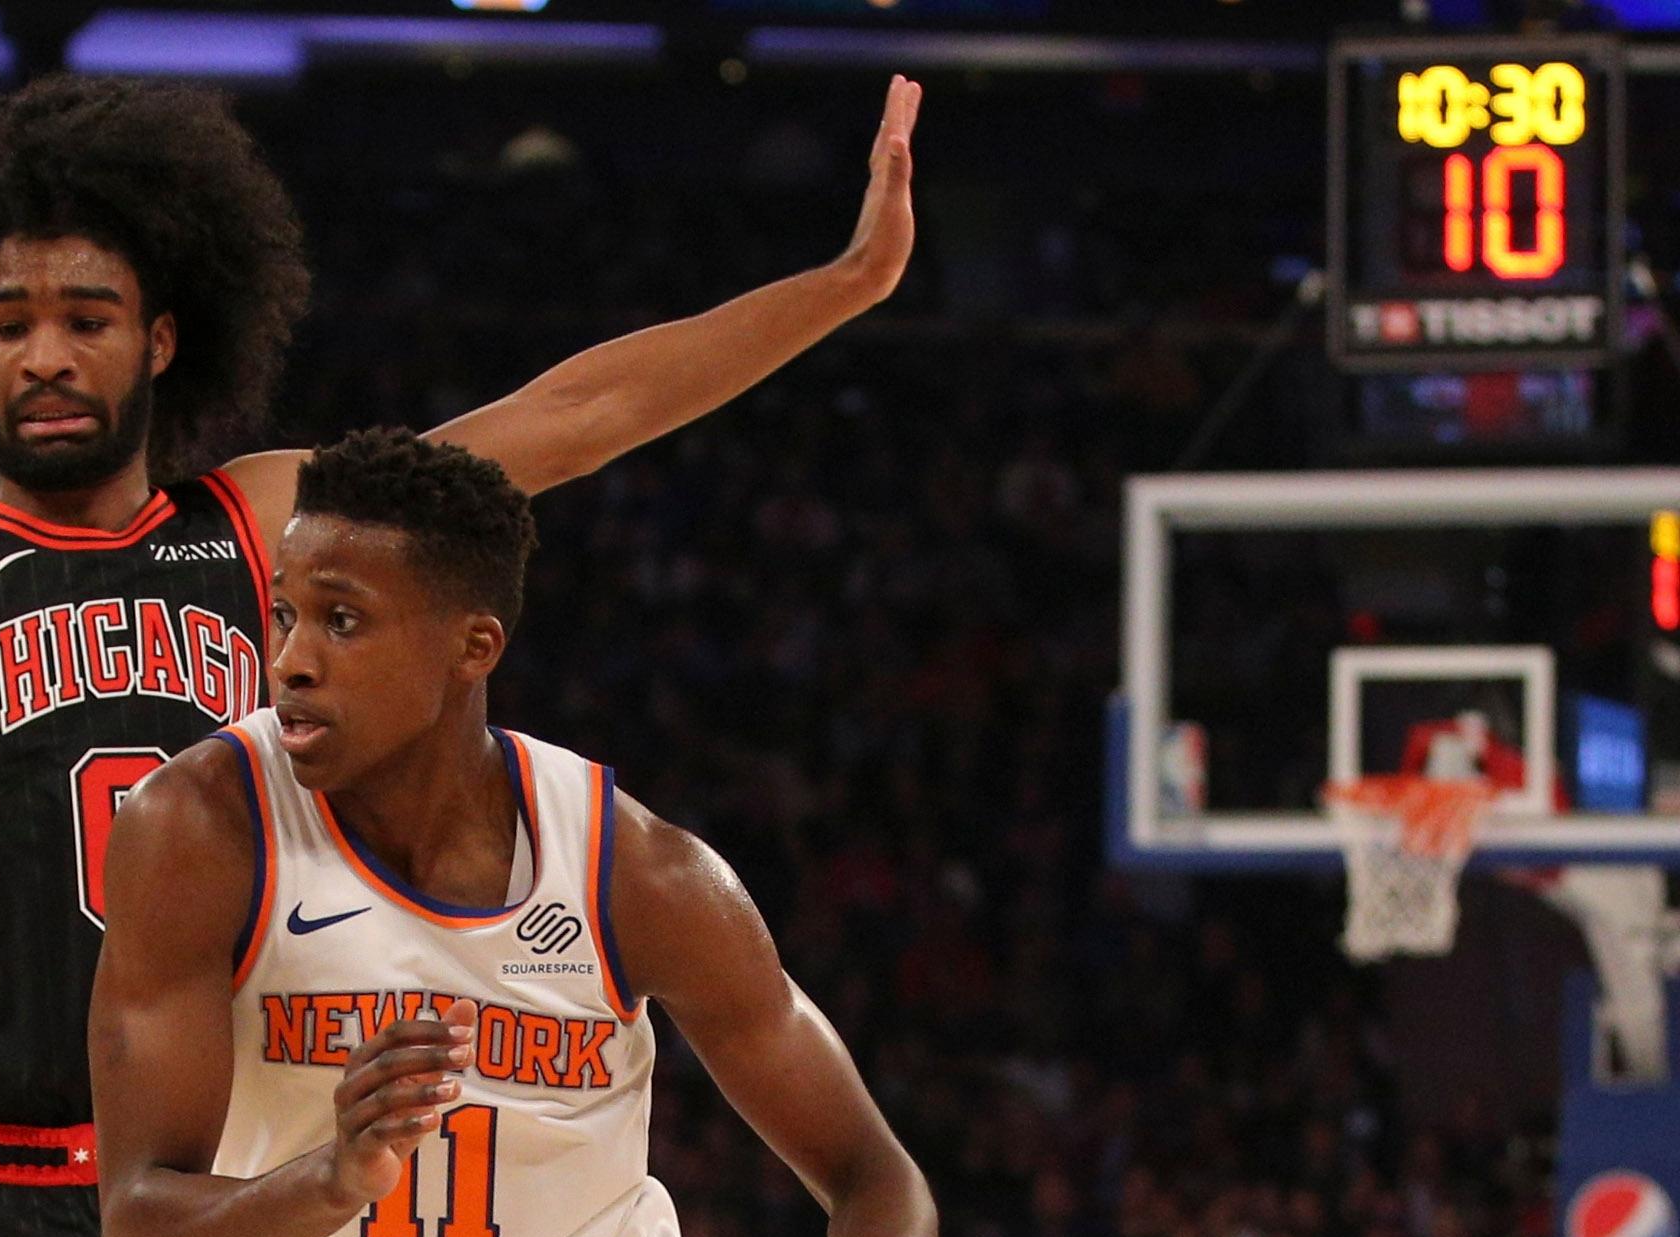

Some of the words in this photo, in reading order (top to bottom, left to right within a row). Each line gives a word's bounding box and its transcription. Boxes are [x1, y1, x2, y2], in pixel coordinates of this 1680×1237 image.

[1397, 62, 1586, 148] 10:30
[1443, 143, 1565, 280] 10
[1418, 298, 1602, 344] TISSOT
[501, 962, 595, 976] SQUARESPACE
